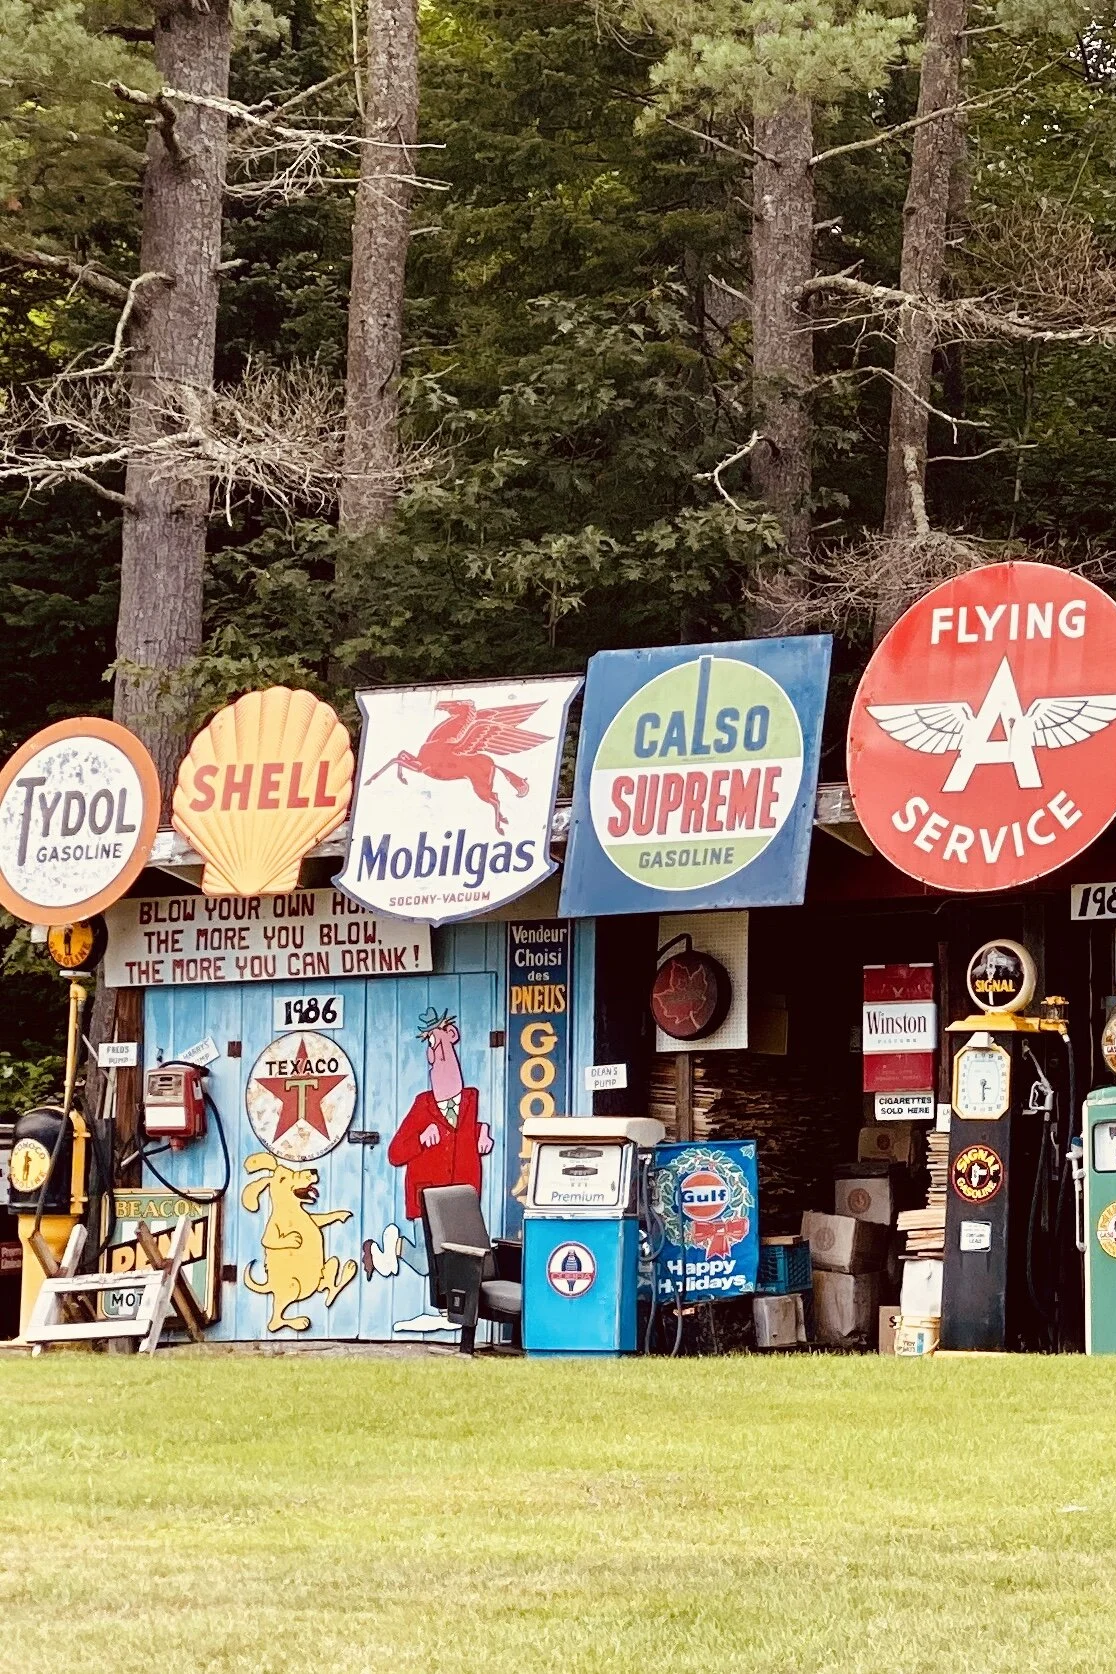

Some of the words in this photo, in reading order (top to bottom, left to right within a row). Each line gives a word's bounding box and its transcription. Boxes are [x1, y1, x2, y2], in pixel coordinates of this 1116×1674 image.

[931, 599, 1087, 644] FLYING
[633, 656, 771, 760] CALSO
[941, 655, 1043, 792] A
[189, 760, 337, 812] SHELL
[607, 766, 782, 838] SUPREME
[15, 776, 137, 867] TYDOL
[891, 790, 1083, 864] SERVICE
[36, 842, 124, 864] GASOLINE
[357, 828, 537, 888] Mobilgas
[638, 846, 735, 869] GASOLINE
[139, 899, 196, 925] BLOW
[205, 896, 261, 921] YOUR
[273, 893, 315, 918] OWN
[332, 893, 373, 915] HO
[389, 890, 491, 907] SOCONY-VACUUM
[143, 930, 184, 954] THE
[196, 927, 251, 951] MORE
[264, 925, 304, 949] YOU
[320, 921, 382, 946] BLOW,
[511, 924, 567, 944] Vendeur
[125, 959, 164, 984] THE
[172, 956, 226, 982] MORE
[235, 954, 277, 979] YOU
[288, 950, 330, 976] CAN
[514, 948, 562, 968] Choisi
[527, 970, 550, 981] des
[975, 979, 1016, 993] SIGNAL
[511, 984, 566, 1014] PNEUS
[284, 997, 338, 1025] 1986
[867, 1011, 927, 1034] Winston
[266, 1057, 339, 1076] TEXACO
[594, 1078, 617, 1088] PUMP
[879, 1096, 932, 1106] CIGARETTES
[881, 1106, 904, 1115] SOLD
[907, 1105, 930, 1114] HERE
[956, 1148, 999, 1174] SIGNAL
[551, 1191, 605, 1203] Premium
[682, 1190, 727, 1203] Gulf
[956, 1176, 997, 1199] GASOLINE
[115, 1201, 203, 1219] BEACON
[667, 1260, 736, 1276] Happy
